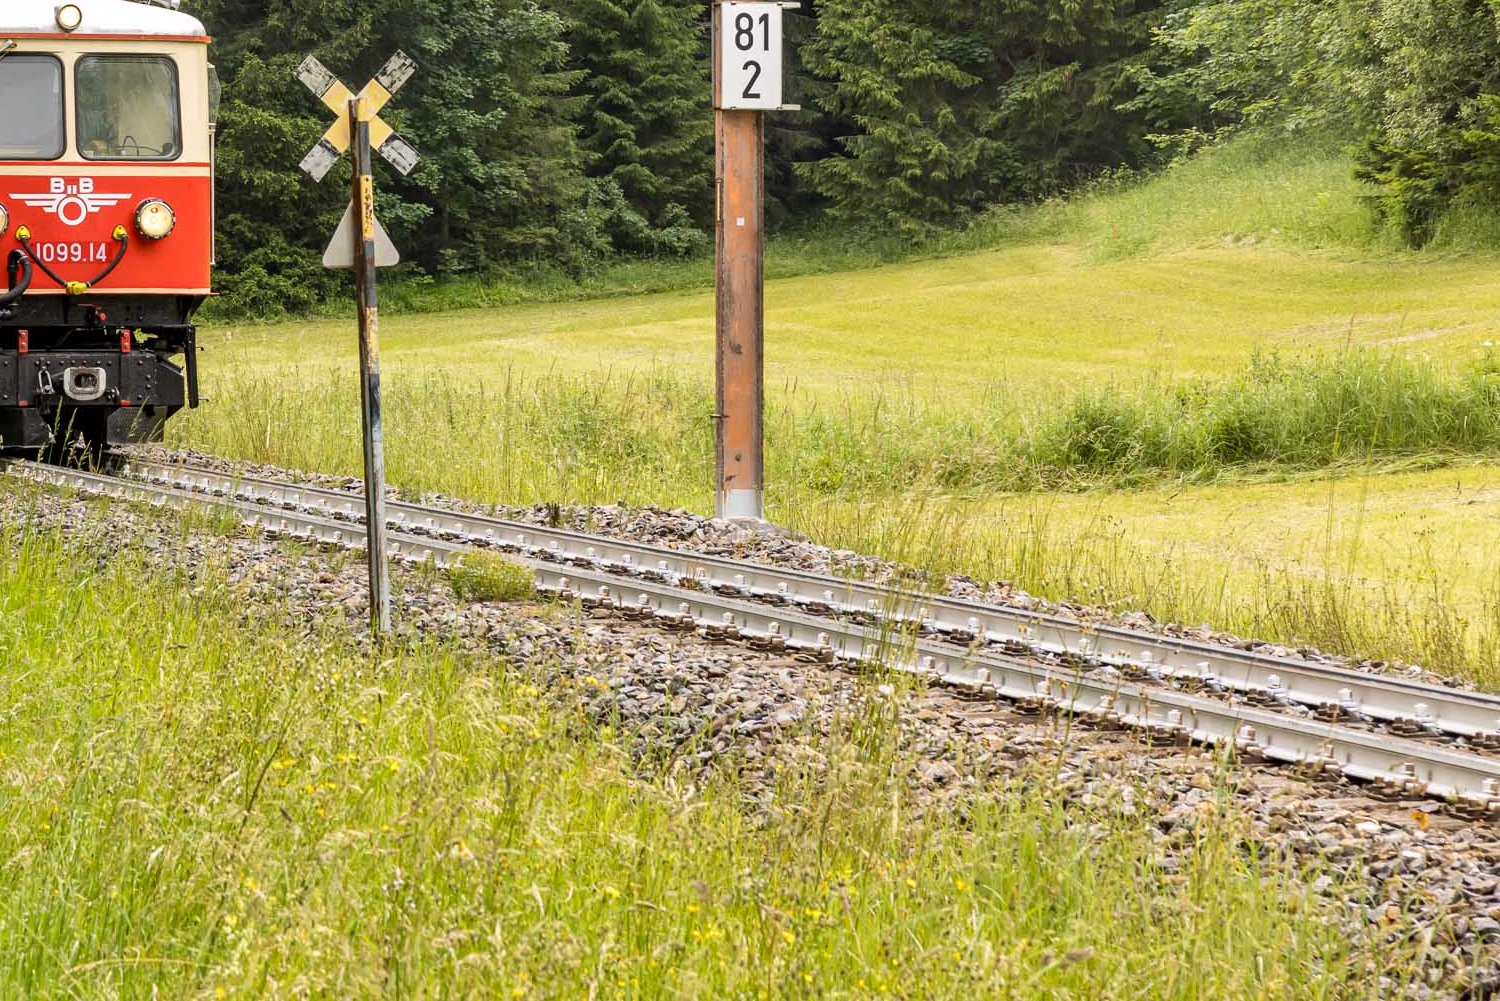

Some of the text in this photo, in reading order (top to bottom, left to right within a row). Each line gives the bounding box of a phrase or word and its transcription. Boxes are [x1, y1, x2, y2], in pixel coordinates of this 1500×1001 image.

[734, 12, 770, 51] 81
[742, 60, 762, 99] 2
[36, 242, 107, 262] 1099.14
